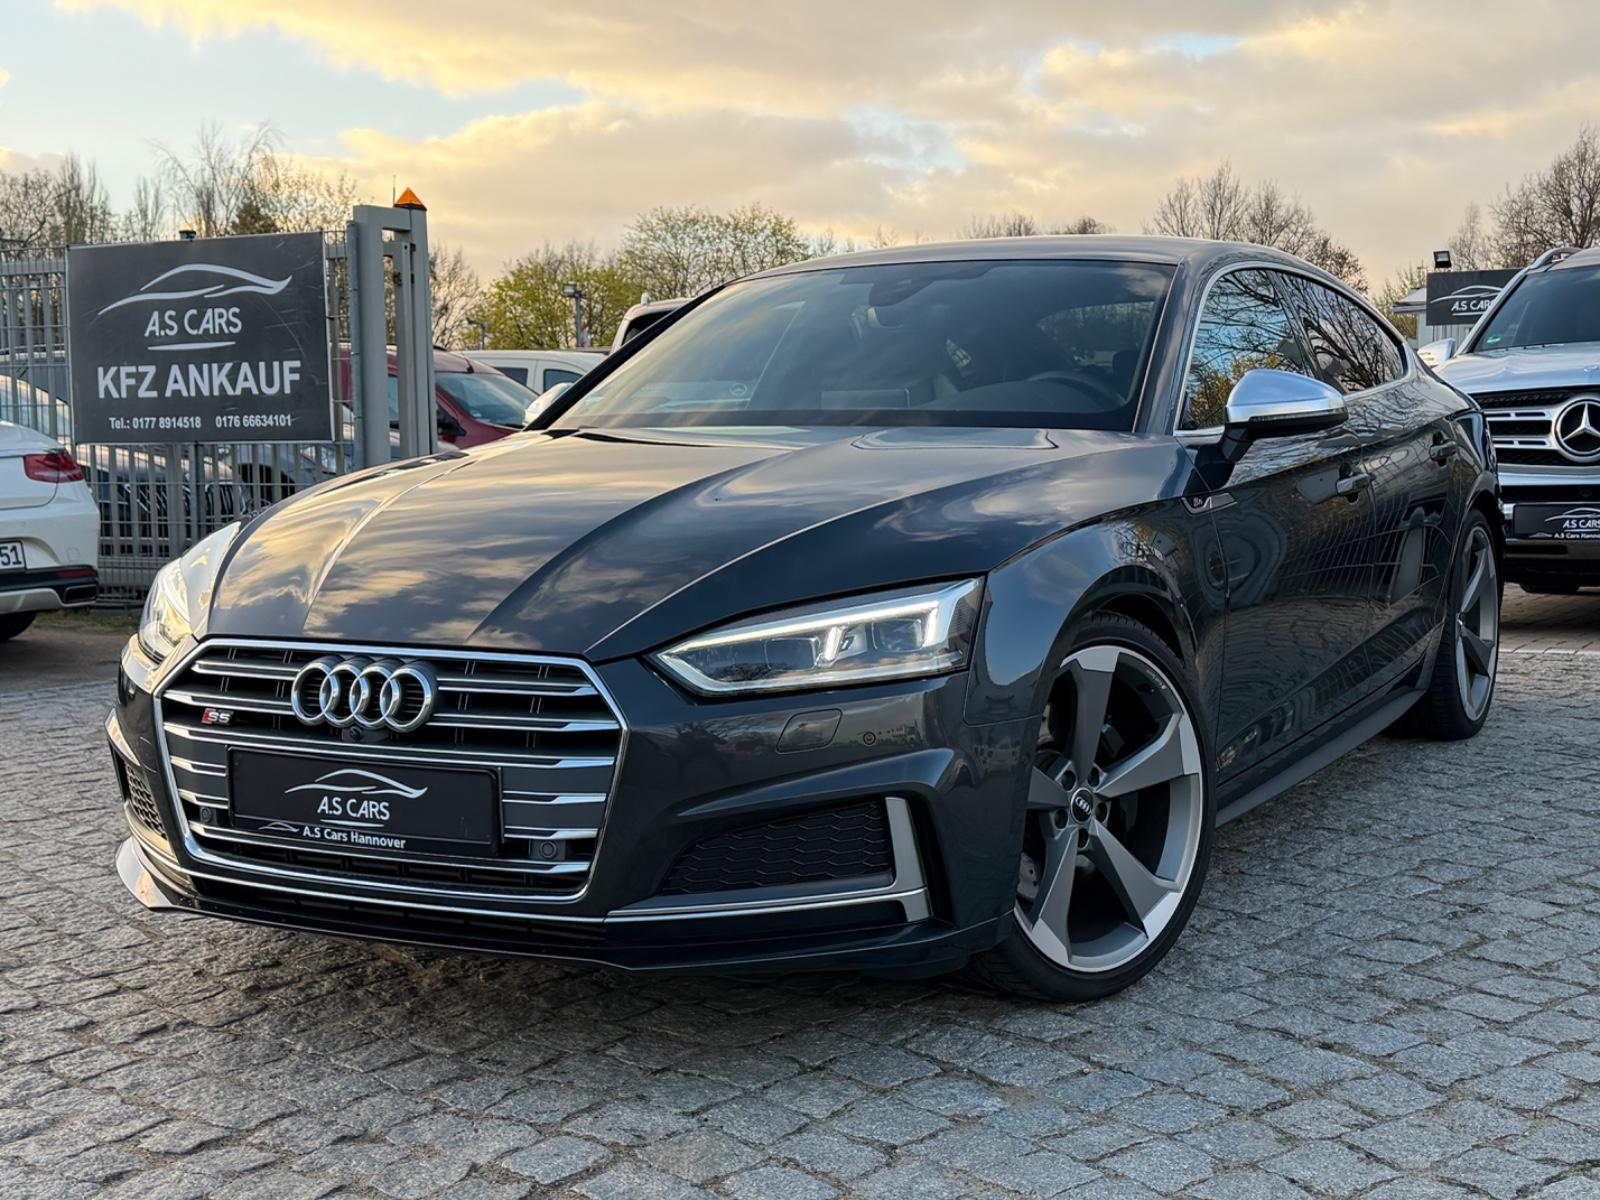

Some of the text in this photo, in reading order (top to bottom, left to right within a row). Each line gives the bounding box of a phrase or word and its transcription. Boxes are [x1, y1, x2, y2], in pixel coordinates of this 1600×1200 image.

[1451, 299, 1491, 311] A.S CAR
[144, 307, 242, 337] A.S CARS
[97, 360, 301, 399] KFZ ANKAUF
[109, 414, 292, 430] Tel.: 0177 8914518 0176 66634101
[1562, 519, 1577, 529] A.S
[0, 545, 22, 566] 51
[317, 796, 390, 820] A.S CARS
[303, 826, 406, 849] A.S Cars Hannover
